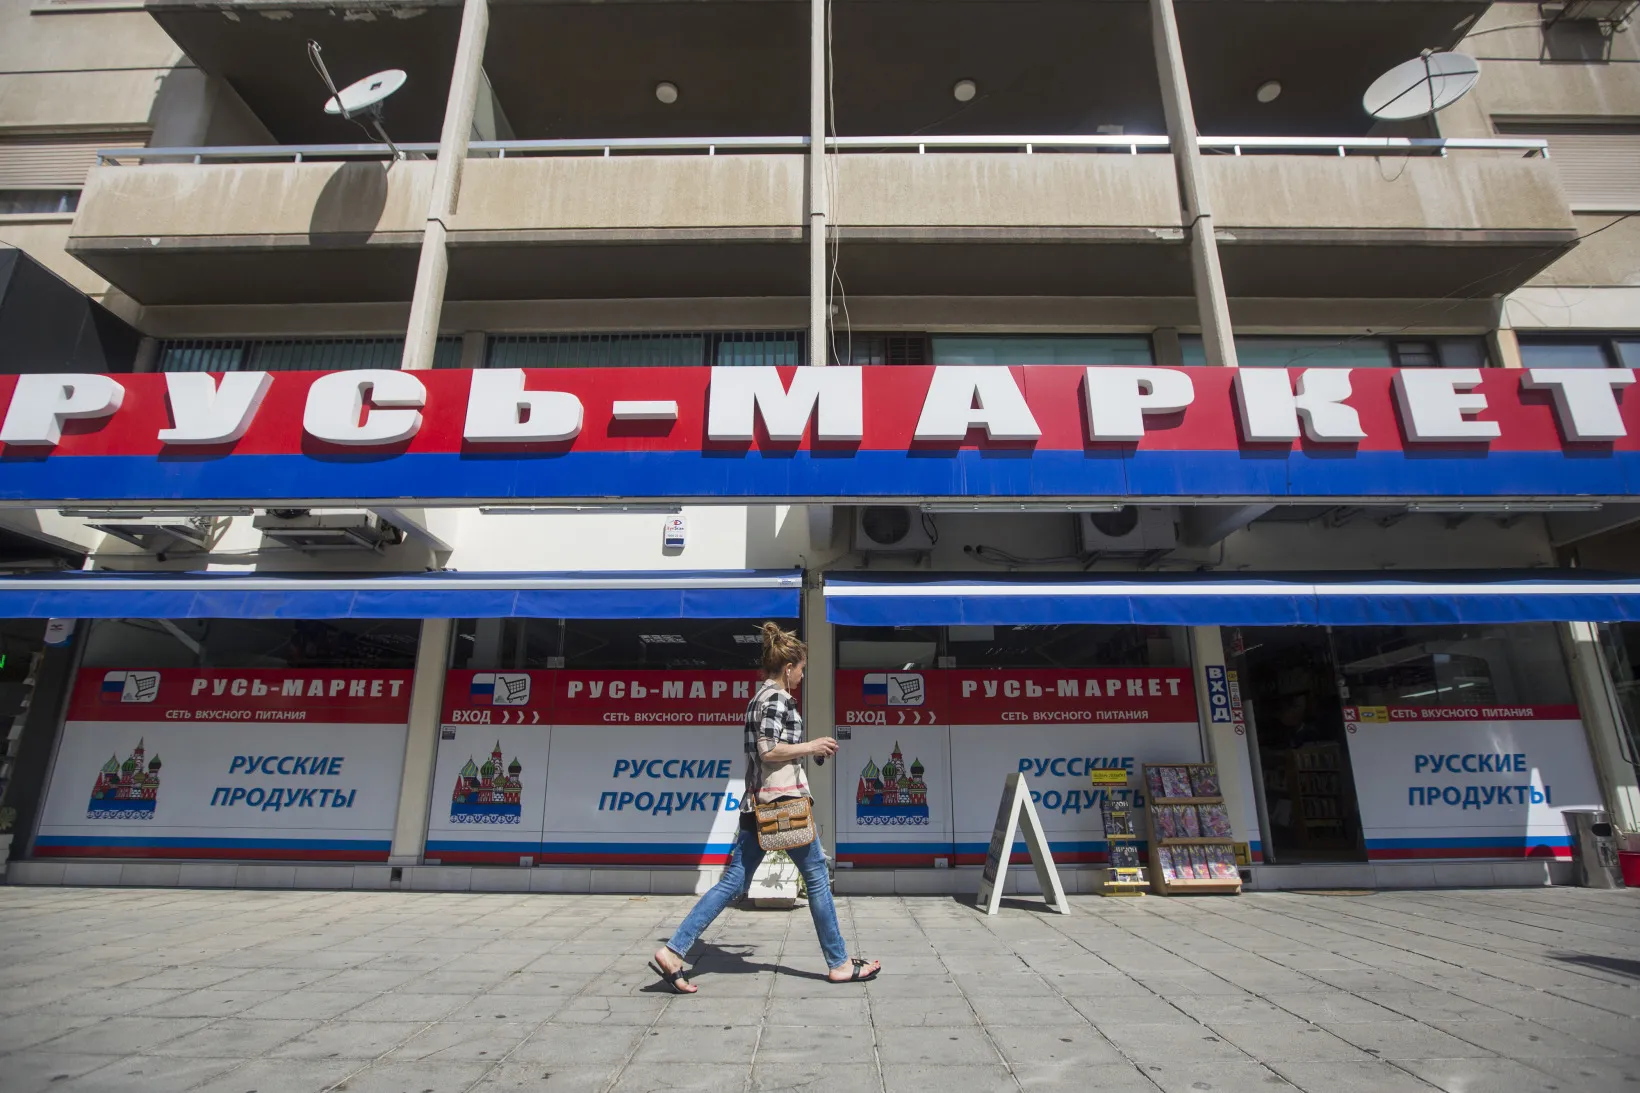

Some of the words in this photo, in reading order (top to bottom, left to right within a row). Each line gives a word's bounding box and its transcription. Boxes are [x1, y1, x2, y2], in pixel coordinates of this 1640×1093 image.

[0, 365, 1636, 447] РУСЬ-МАРКЕТ
[191, 678, 404, 698] РУСЬ-МАРКЕТ
[567, 680, 761, 699] РУСЬ-МАРК
[961, 678, 1181, 698] РУСЬ-МАРКЕТ
[1208, 668, 1230, 721] ВХОД
[165, 710, 191, 720] СЕТЬ
[195, 710, 251, 720] ВКУСНОГО
[255, 710, 306, 720] ПИТАНИЯ
[452, 710, 491, 725] ВХОД
[603, 712, 630, 722] СЕТЬ
[634, 712, 694, 722] ВКУСНОГО
[846, 710, 887, 725] ВХОД
[1001, 711, 1029, 721] СЕТЬ
[1033, 710, 1092, 720] ВКУСНОГО
[1096, 709, 1150, 720] ПИТАНИЯ
[1391, 708, 1418, 719] СЕТЬ
[1421, 708, 1478, 719] ВКУСНОГО
[1482, 707, 1533, 718] ПИТАНИЯ
[229, 755, 342, 776] РУССКИЕ
[613, 758, 731, 779] РУССКИЕ
[1018, 756, 1134, 777] РУССКИЕ
[1415, 753, 1527, 774] РУССКИЕ
[211, 787, 356, 812] ПРОДУКТЫ
[1408, 784, 1553, 810] ПРОДУКТЫ
